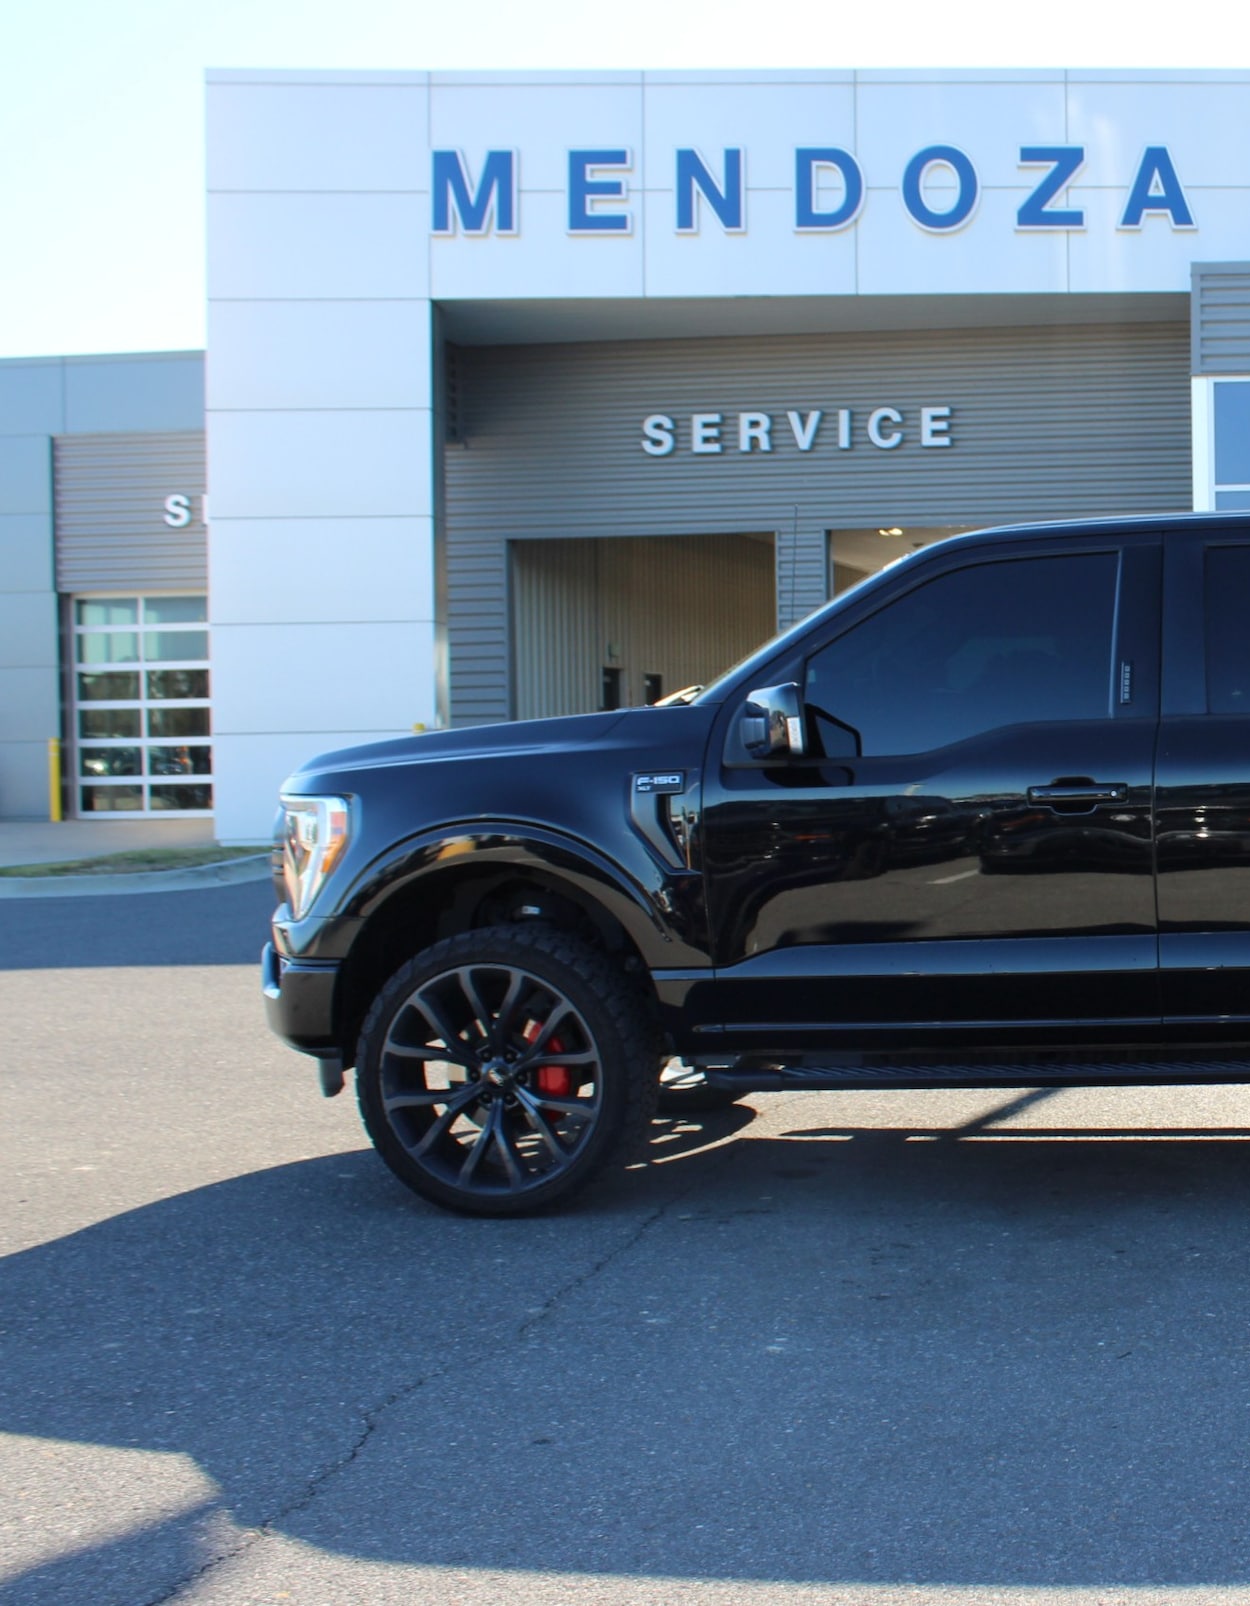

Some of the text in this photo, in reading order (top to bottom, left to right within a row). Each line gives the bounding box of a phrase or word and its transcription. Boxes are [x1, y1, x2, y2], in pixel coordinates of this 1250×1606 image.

[431, 145, 1197, 236] MENDOZA
[641, 407, 954, 456] SERVICE
[163, 494, 208, 527] S
[637, 775, 680, 785] F-150
